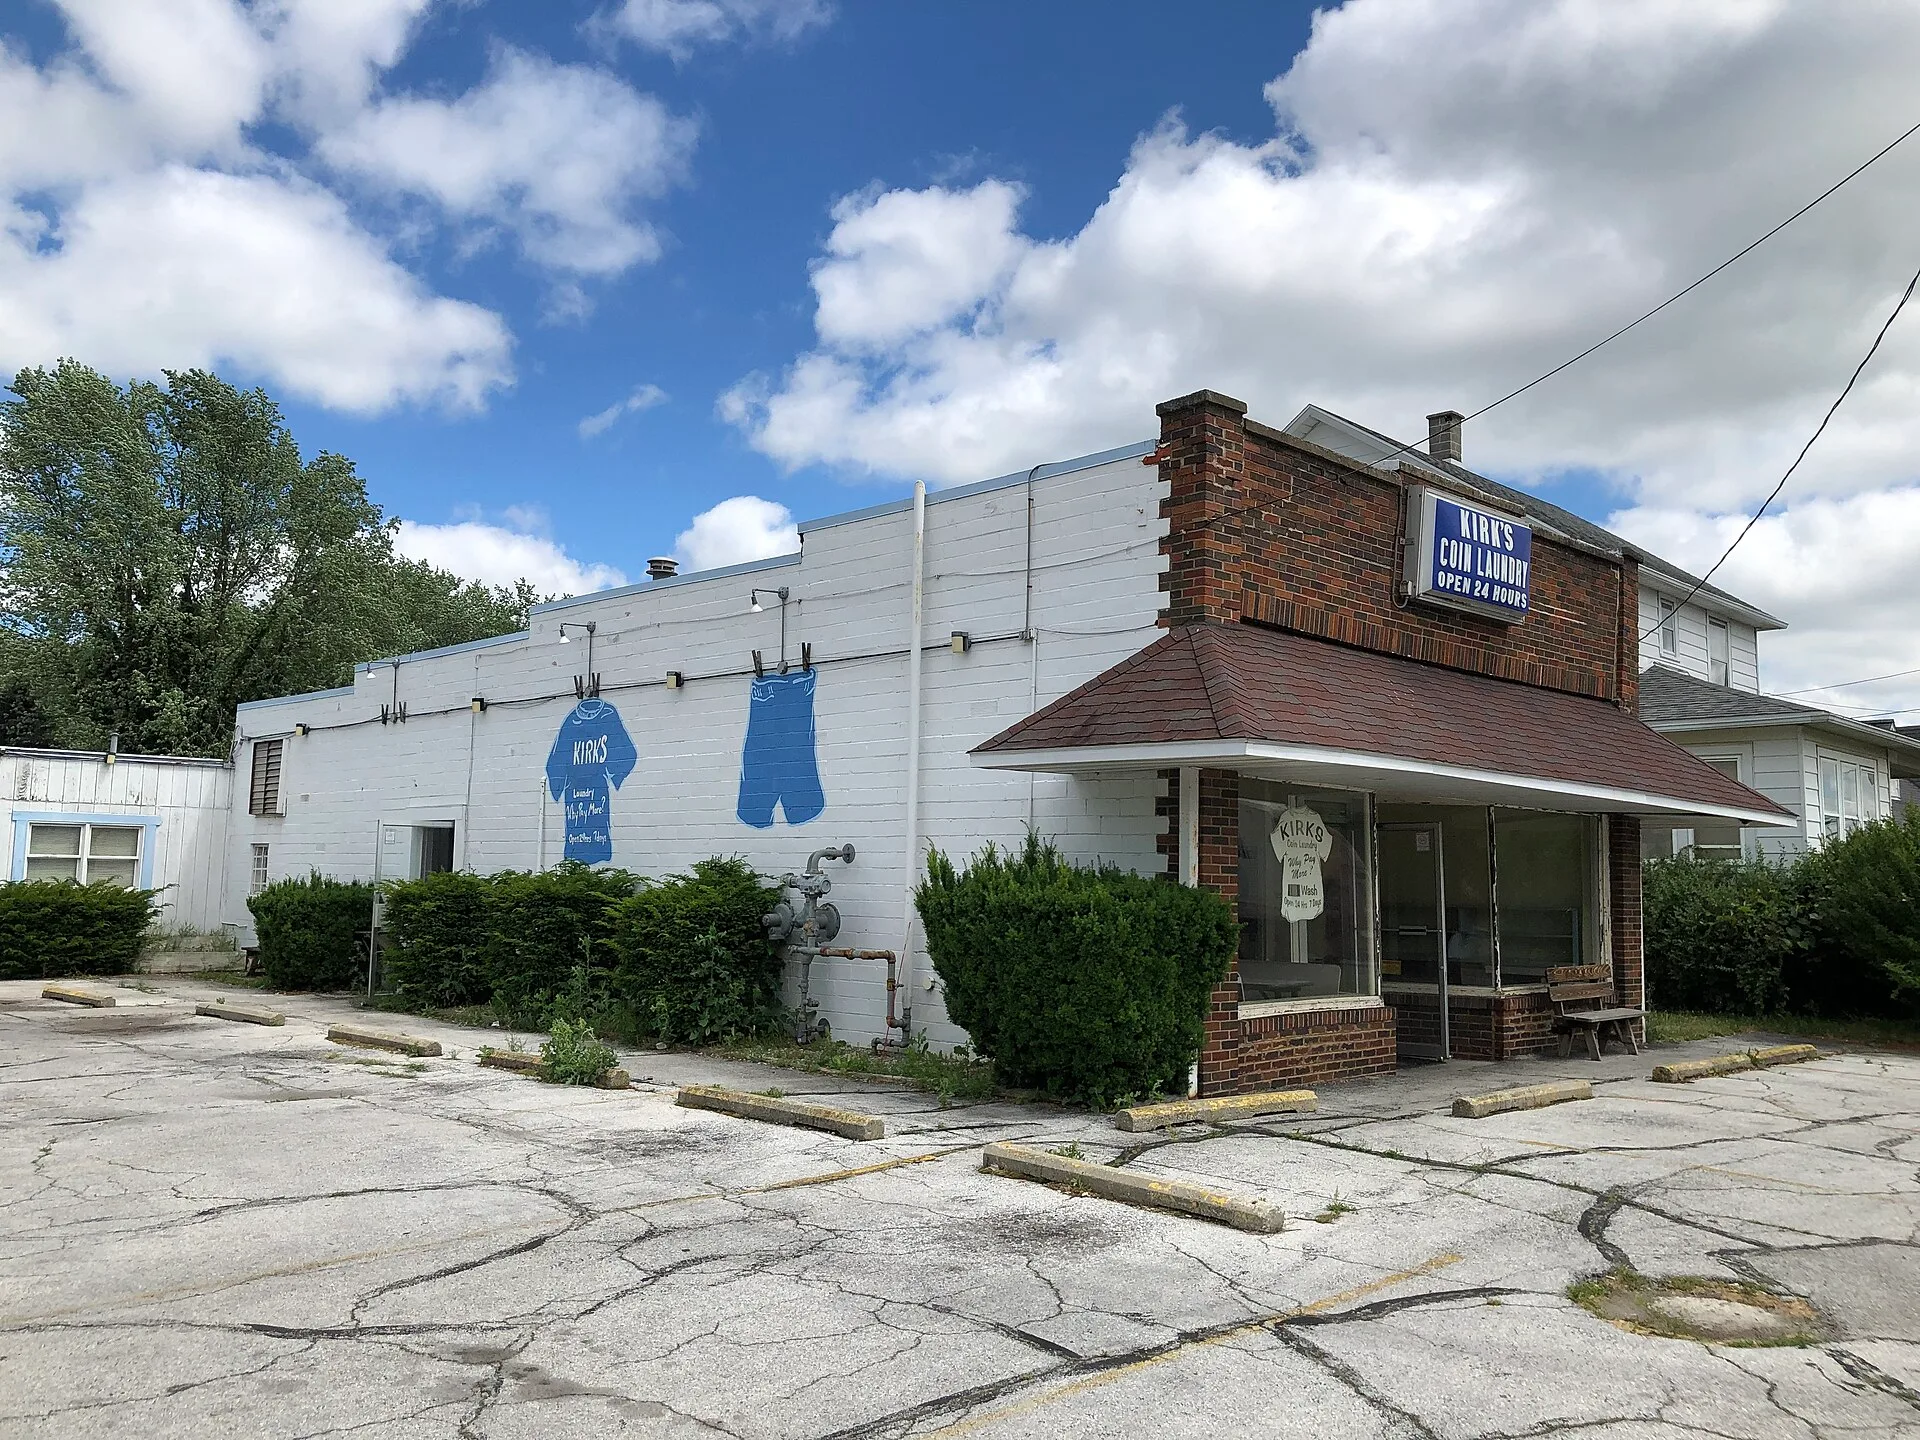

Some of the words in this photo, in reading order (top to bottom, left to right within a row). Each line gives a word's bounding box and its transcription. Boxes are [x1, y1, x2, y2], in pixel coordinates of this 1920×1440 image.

[1460, 508, 1514, 552] KIRK'S
[1440, 537, 1472, 573] COIN
[1477, 547, 1528, 588] LAUNDRY
[1438, 571, 1471, 594] OPEN
[1473, 580, 1490, 599] 24
[1492, 584, 1527, 609] HOURS
[573, 735, 608, 766] KIRKS
[573, 788, 595, 800] Laundry
[566, 803, 579, 827] Why
[578, 802, 588, 824] Pay
[588, 796, 606, 816] More?
[1280, 819, 1324, 843] KIRKS
[1286, 839, 1298, 848] Coin
[1298, 839, 1318, 851] Laundry
[1287, 856, 1302, 868] Why
[1303, 853, 1316, 864] Pay
[1284, 896, 1294, 907] Open
[1301, 884, 1318, 896] Wash
